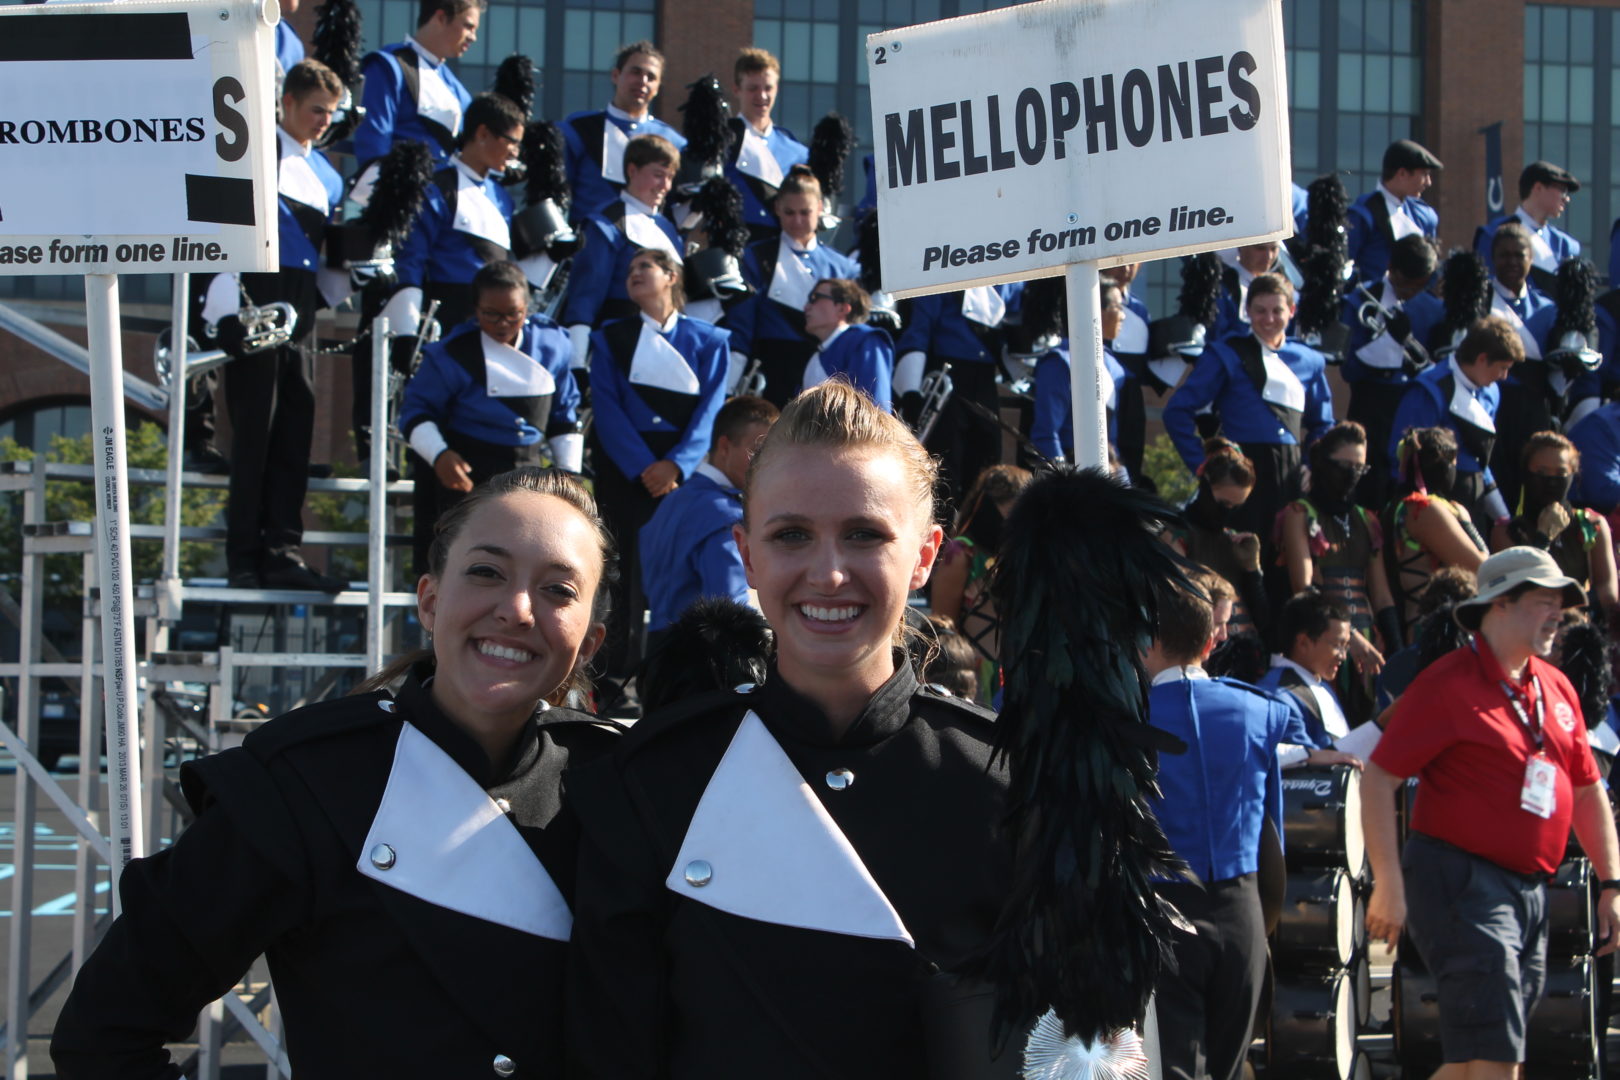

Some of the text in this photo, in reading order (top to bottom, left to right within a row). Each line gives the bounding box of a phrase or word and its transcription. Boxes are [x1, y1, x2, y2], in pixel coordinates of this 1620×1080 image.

[875, 47, 887, 65] 2
[0, 118, 206, 144] ROMBONES
[212, 76, 249, 162] S
[885, 51, 1261, 188] MELLOPHONES
[0, 237, 228, 264] ase form one line.
[922, 206, 1234, 272] Please form one line.
[105, 436, 115, 470] JM EAGLE
[111, 543, 119, 551] 40
[112, 552, 120, 580] PVC1120
[114, 627, 122, 647] ASTM
[119, 751, 127, 767] 2013
[119, 767, 128, 783] MAR
